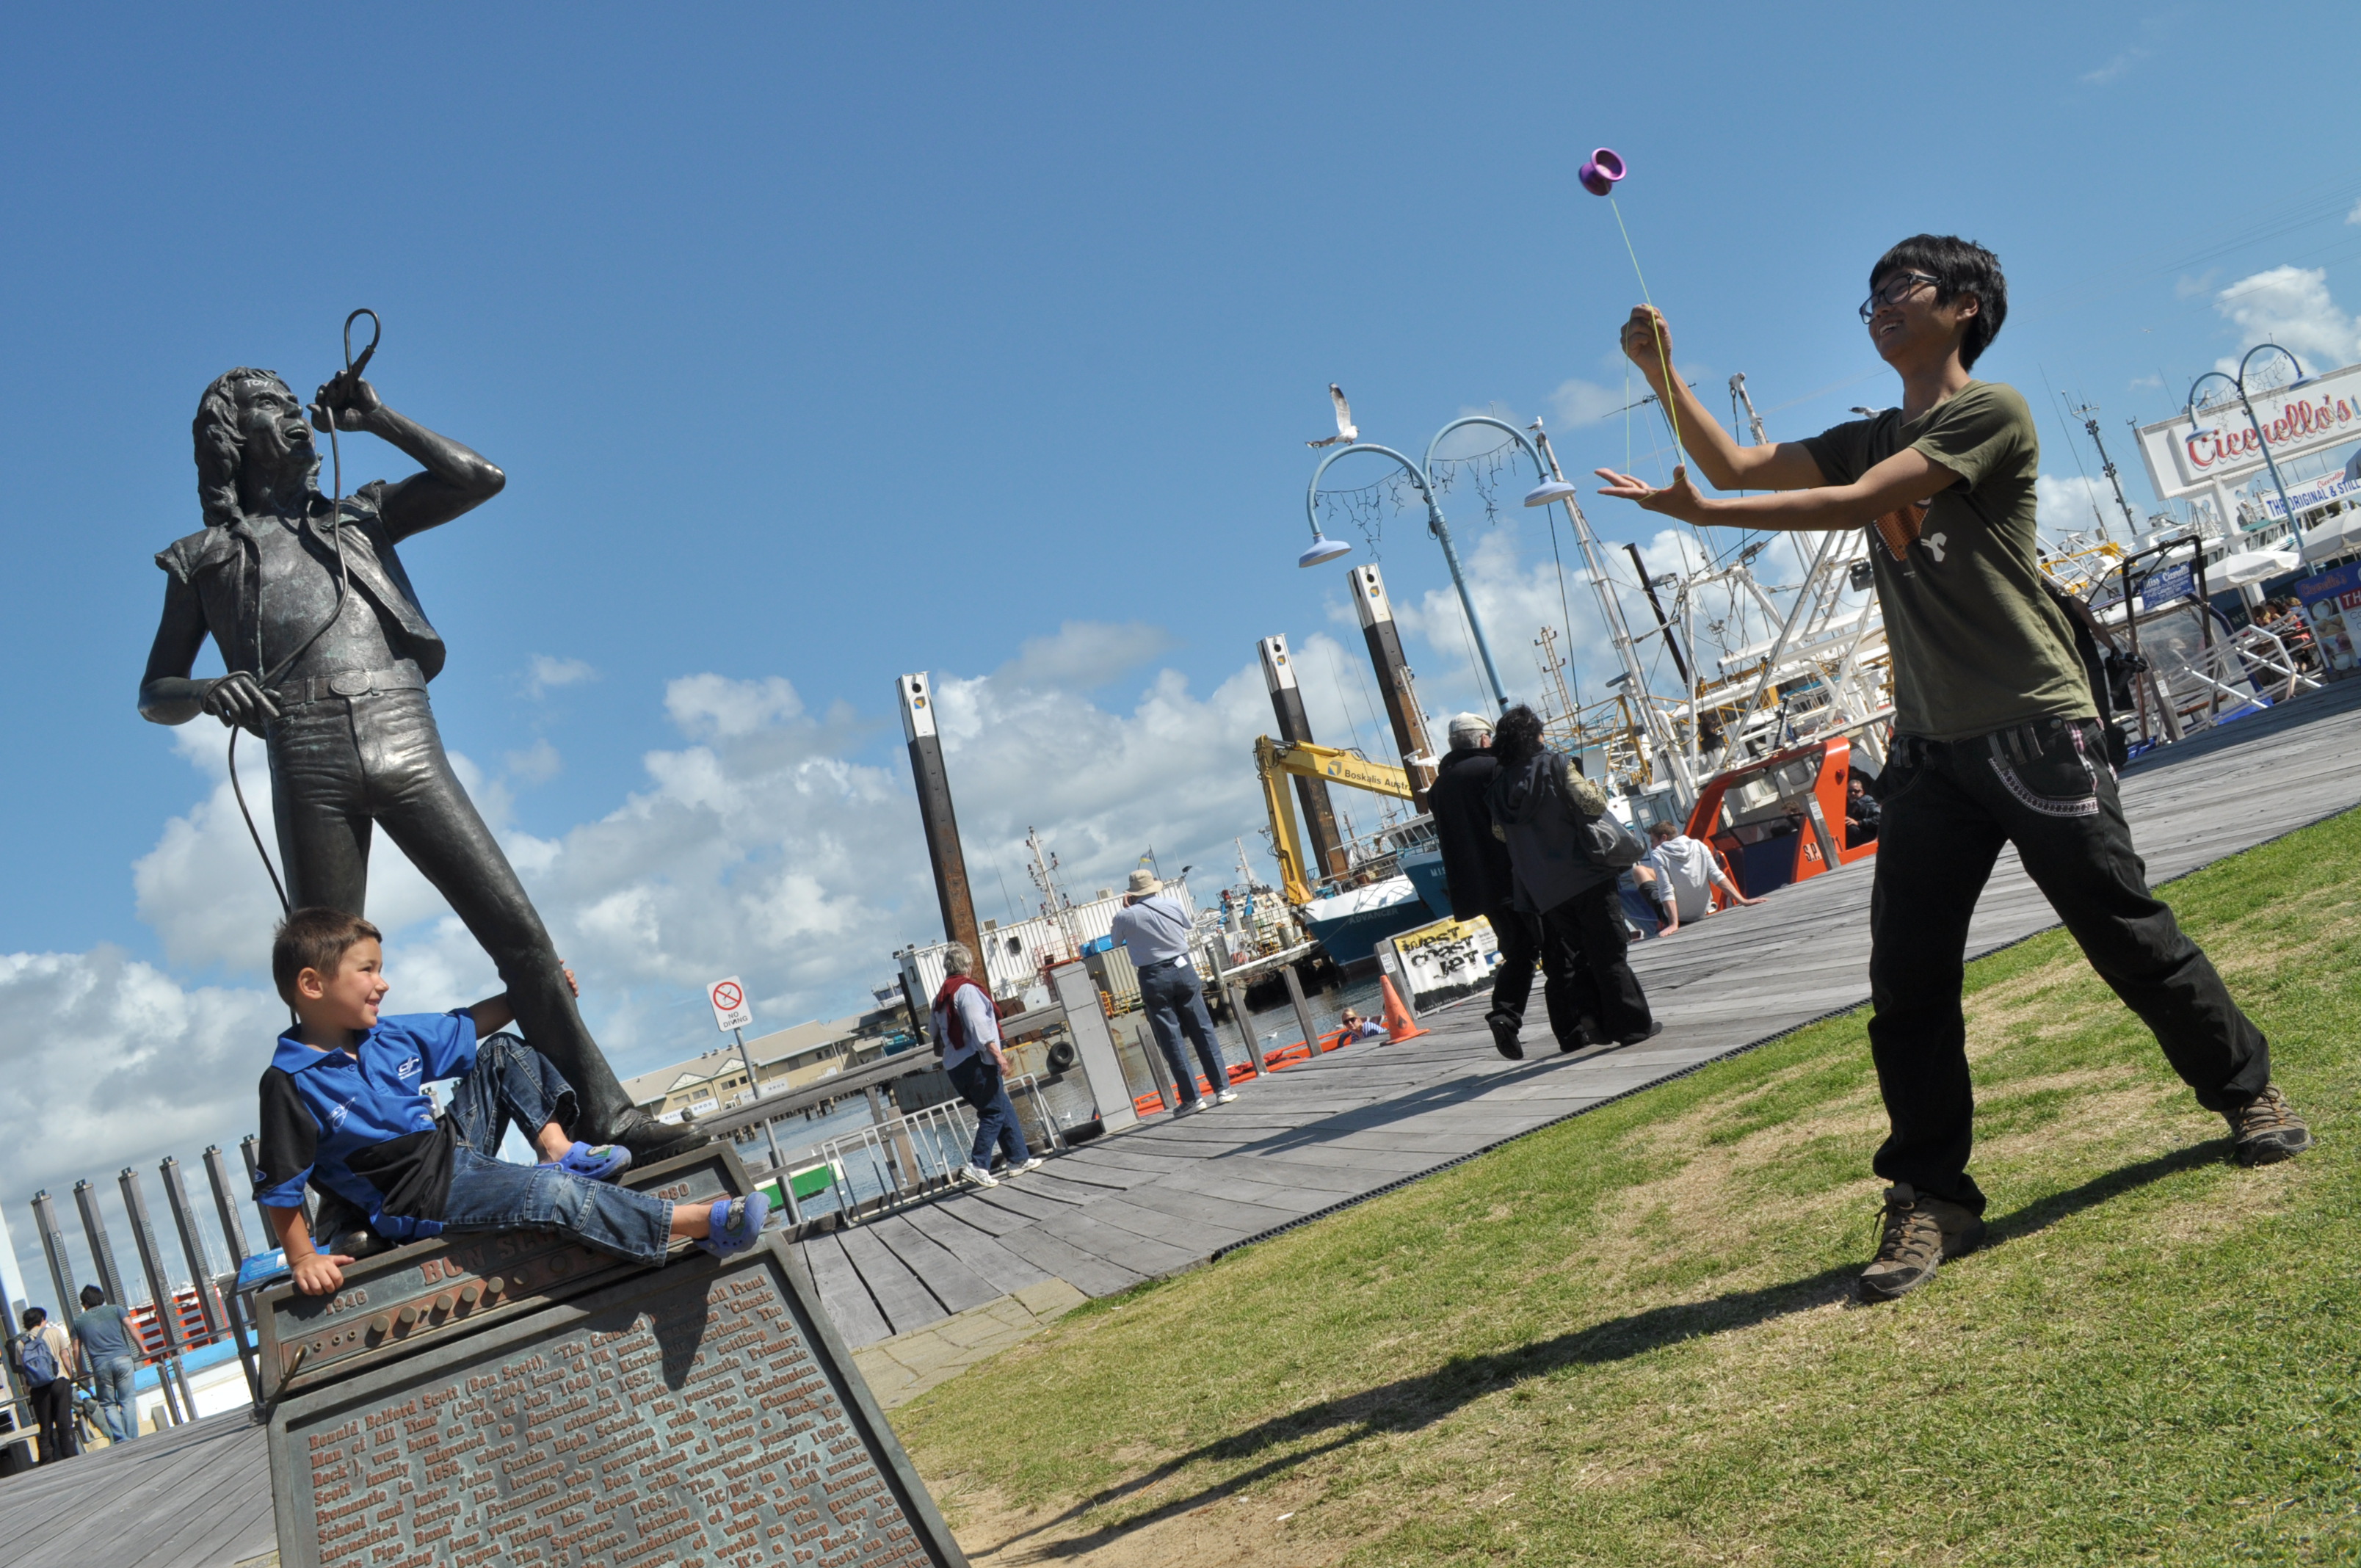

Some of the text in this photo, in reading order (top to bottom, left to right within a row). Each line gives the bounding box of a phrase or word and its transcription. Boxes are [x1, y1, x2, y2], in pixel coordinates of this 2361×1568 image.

[2188, 394, 2352, 467] Cicerello's
[2329, 485, 2337, 497] &
[1344, 769, 1382, 785] Boskalis
[1349, 907, 1399, 924] ADVANCER
[723, 1015, 748, 1028] DIVING
[325, 1288, 369, 1316] 1946
[420, 1245, 486, 1286] BON
[310, 1420, 358, 1451] Ronald
[366, 1399, 417, 1429] Belford
[422, 1384, 458, 1409] Scott
[465, 1372, 498, 1395] (Bon
[501, 1354, 548, 1381] Scott),
[552, 1340, 586, 1360] "The
[730, 1274, 766, 1296] Front
[311, 1446, 342, 1469] Man
[351, 1436, 366, 1454] of
[374, 1426, 396, 1445] All
[451, 1395, 487, 1420] (July
[492, 1379, 526, 1403] 2004
[531, 1365, 567, 1388] issue
[571, 1356, 587, 1373] of
[590, 1348, 612, 1365] UK
[615, 1333, 655, 1357] music
[724, 1289, 775, 1315] 'Classic
[313, 1458, 363, 1489] Rock'),
[372, 1445, 399, 1465] was
[407, 1430, 440, 1452] born
[471, 1409, 495, 1429] 9th
[501, 1401, 517, 1418] of
[523, 1389, 552, 1411] July
[559, 1373, 592, 1396] 1946
[598, 1367, 614, 1382] in
[756, 1304, 783, 1321] The
[314, 1318, 793, 1506] Scott family migrated to Australia in 1952, settling in
[316, 1488, 386, 1526] Fremantle
[426, 1459, 464, 1486] 1956,
[475, 1440, 517, 1465] where
[526, 1426, 554, 1445] Bon
[562, 1399, 623, 1431] attended
[628, 1382, 668, 1407] North
[747, 1334, 800, 1361] Primary
[317, 1349, 809, 1545] School and later John Curtin High School. His passion for music
[319, 1521, 399, 1564] intensified
[413, 1499, 461, 1528] during
[474, 1484, 498, 1503] his
[509, 1459, 565, 1492] teenage
[575, 1426, 655, 1464] association
[666, 1408, 697, 1429] with
[705, 1393, 739, 1412] 'The
[743, 1362, 818, 1398] Caledonian
[371, 1540, 405, 1564] Pipe
[414, 1519, 457, 1547] Band'
[463, 1509, 479, 1527] of
[486, 1481, 557, 1518] Fremantle
[563, 1467, 594, 1487] who
[601, 1440, 661, 1473] awarded
[665, 1428, 695, 1447] him
[703, 1405, 754, 1431] 'Novice
[759, 1377, 827, 1411] Champion
[448, 1396, 820, 1553] four years running. Bon dreamt being 'Rock
[455, 1542, 502, 1568] began
[509, 1520, 555, 1549] living
[560, 1508, 586, 1527] his
[591, 1487, 639, 1514] dream
[646, 1470, 680, 1492] with
[684, 1442, 753, 1477] voracious
[758, 1416, 817, 1449] passion.
[820, 1405, 843, 1421] He
[506, 1545, 541, 1567] 'The
[548, 1511, 621, 1554] Spectors'
[630, 1492, 674, 1520] 1965,
[681, 1475, 717, 1496] 'The
[722, 1440, 802, 1481] Valentines'
[810, 1420, 852, 1445] 1966-
[579, 1434, 860, 1558] before joining 'AC/DC' 1974 with
[612, 1518, 702, 1564] foundations
[728, 1492, 767, 1516] Rock
[788, 1468, 822, 1490] Roll
[825, 1450, 869, 1476] music
[722, 1465, 878, 1538] what have become
[714, 1478, 888, 1561] world the greatest
[790, 1493, 896, 1550] Long Way To
[792, 1506, 904, 1564] Be Rock', and
[860, 1536, 922, 1568] musical
[861, 1524, 915, 1553] on the
